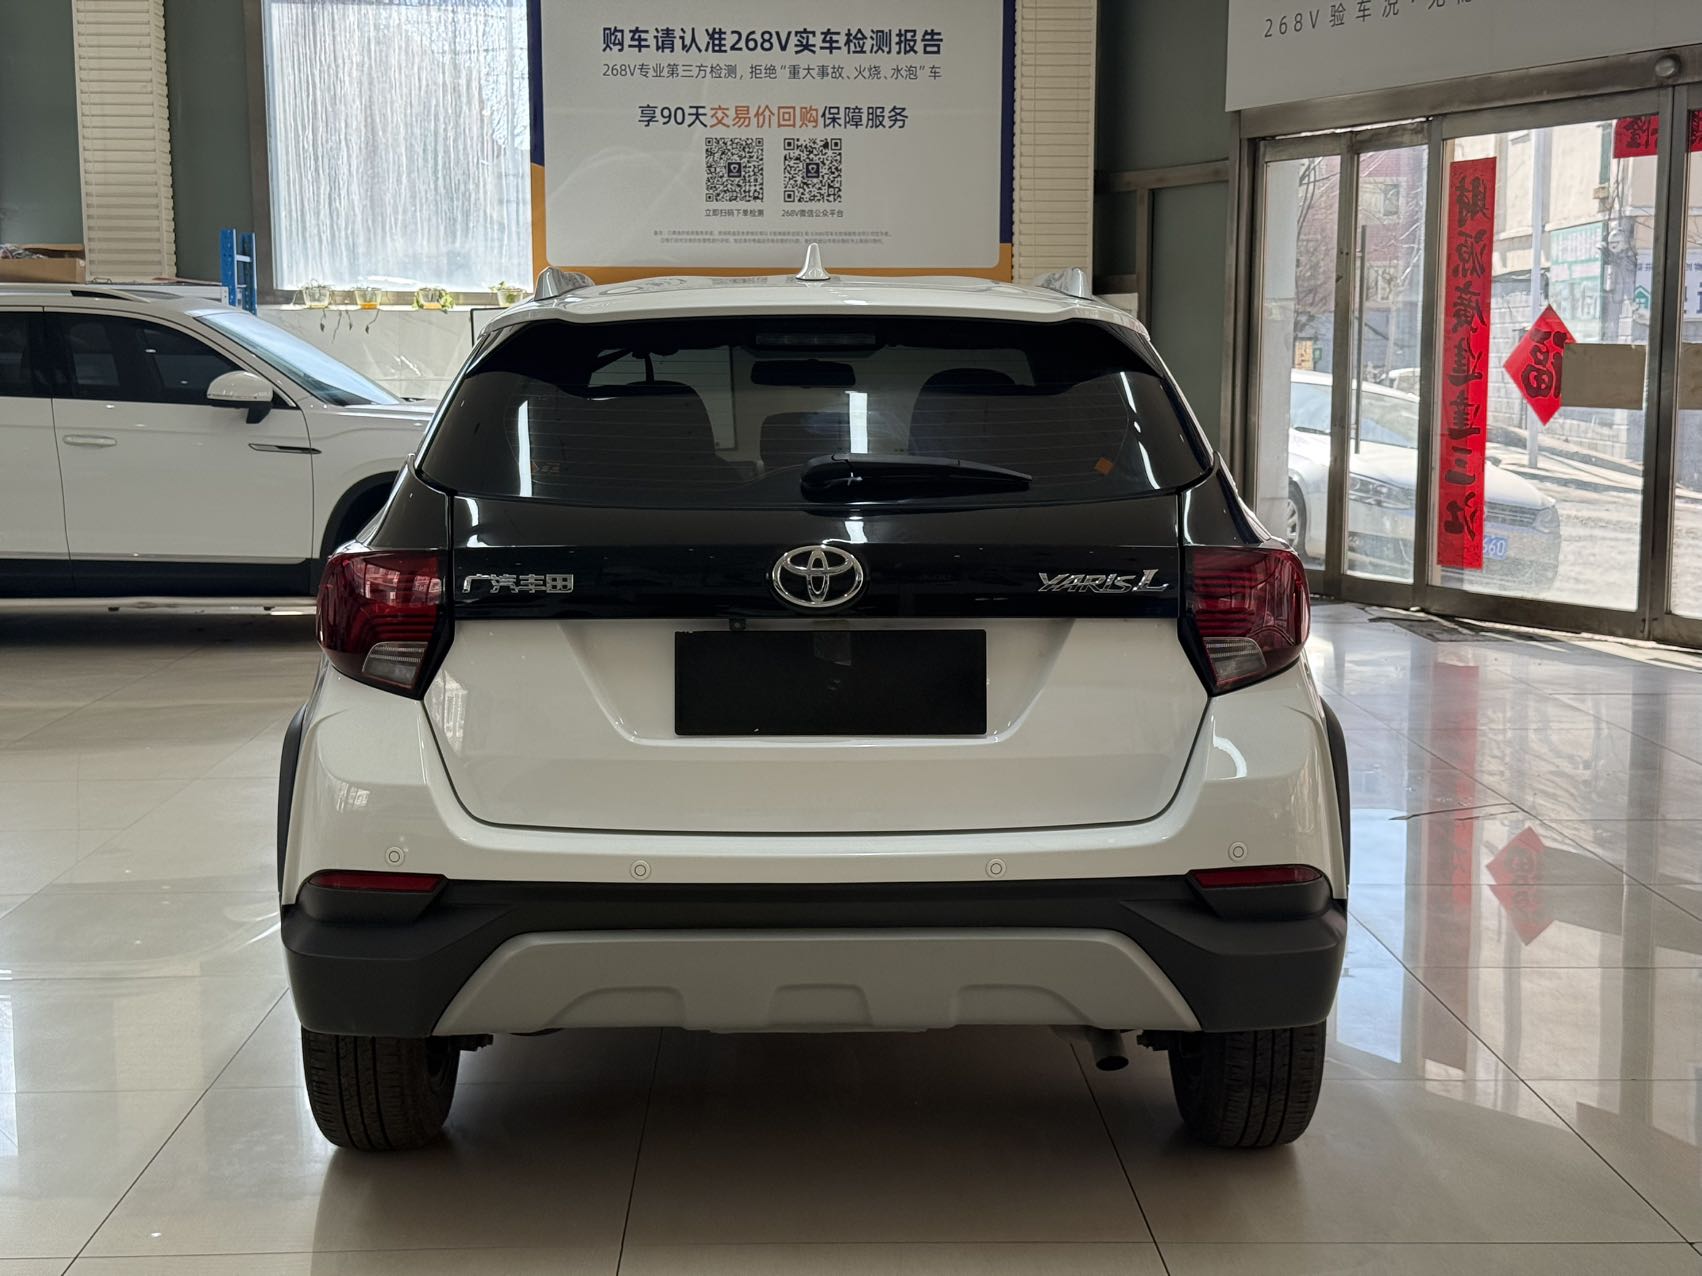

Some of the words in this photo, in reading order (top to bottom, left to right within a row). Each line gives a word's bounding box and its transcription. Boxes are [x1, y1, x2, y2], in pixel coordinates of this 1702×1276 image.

[602, 26, 944, 56] 购车请认准268V实车检测报告
[638, 104, 909, 130] 享90天交易价回购保障服务
[461, 573, 574, 593] 广汽丰田
[1038, 573, 1136, 593] YARIS
[1132, 569, 1169, 592] L
